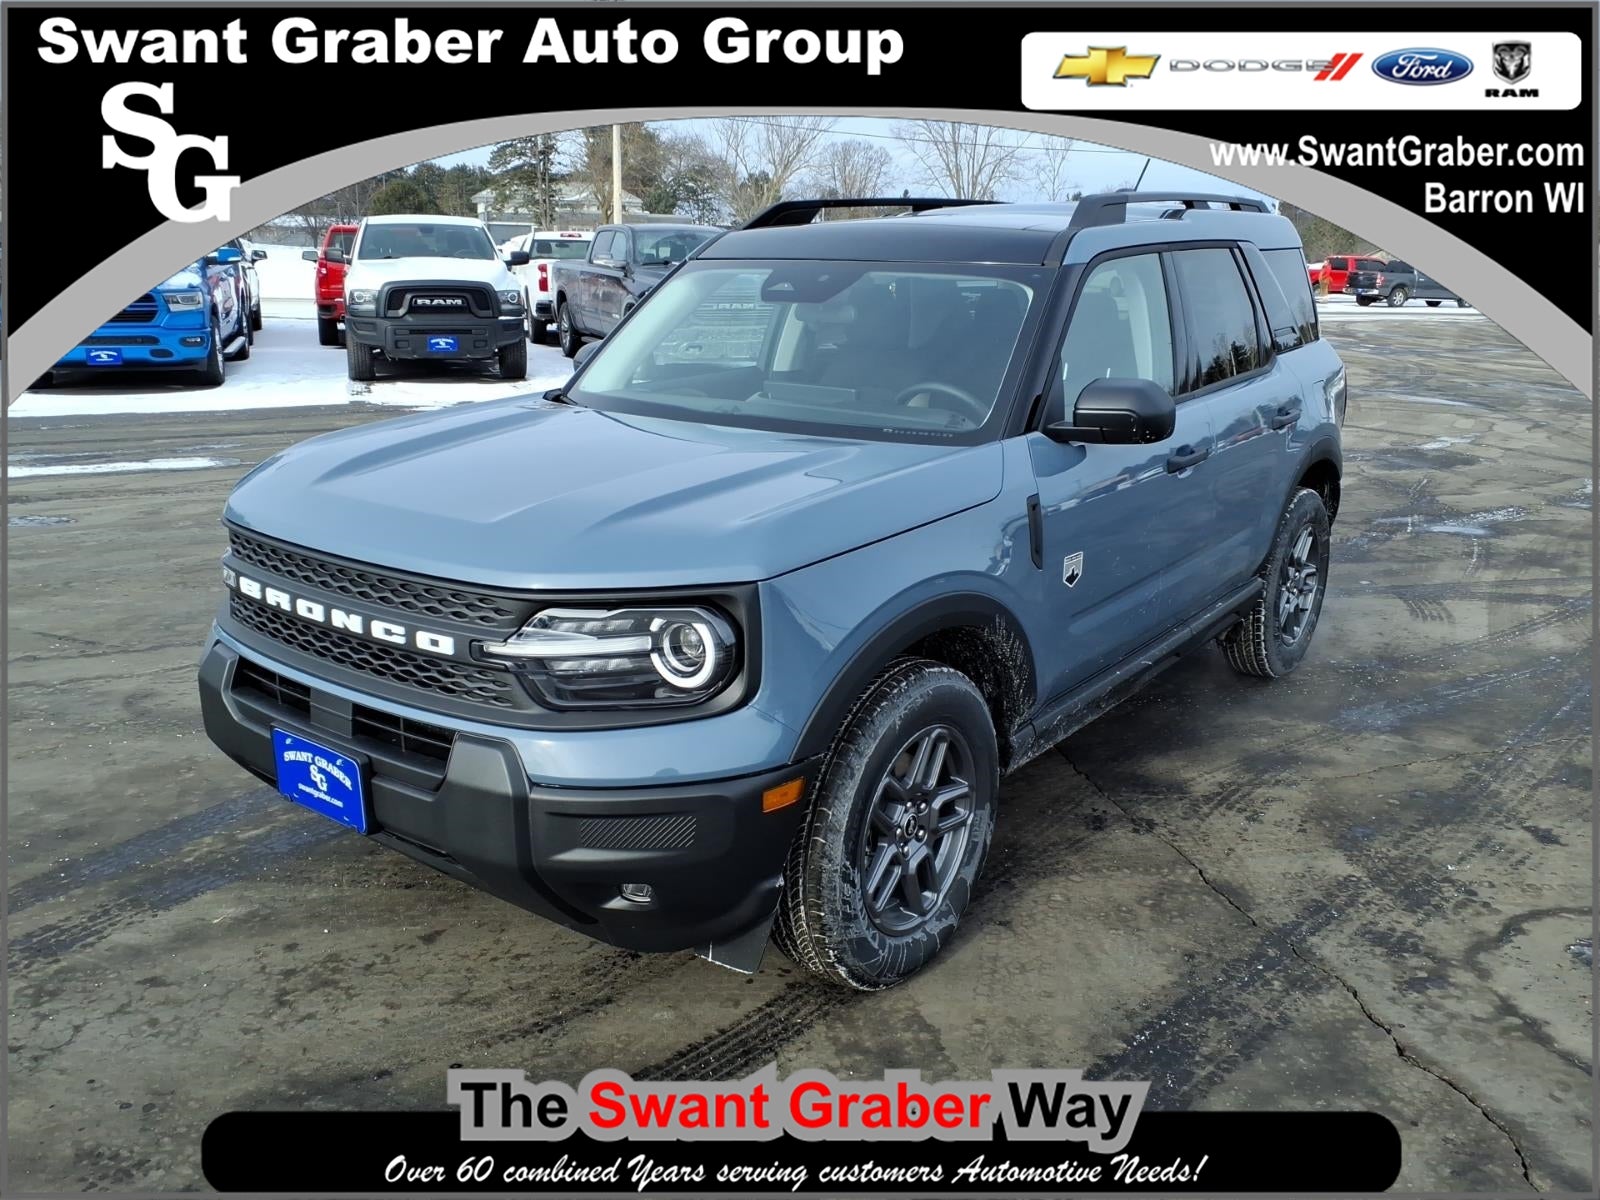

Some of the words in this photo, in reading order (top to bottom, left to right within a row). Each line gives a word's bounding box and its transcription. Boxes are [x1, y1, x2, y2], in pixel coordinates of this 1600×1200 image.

[417, 298, 462, 306] RAM
[238, 575, 455, 656] BRONCO
[283, 750, 313, 764] SWANT
[314, 755, 353, 791] GRABER
